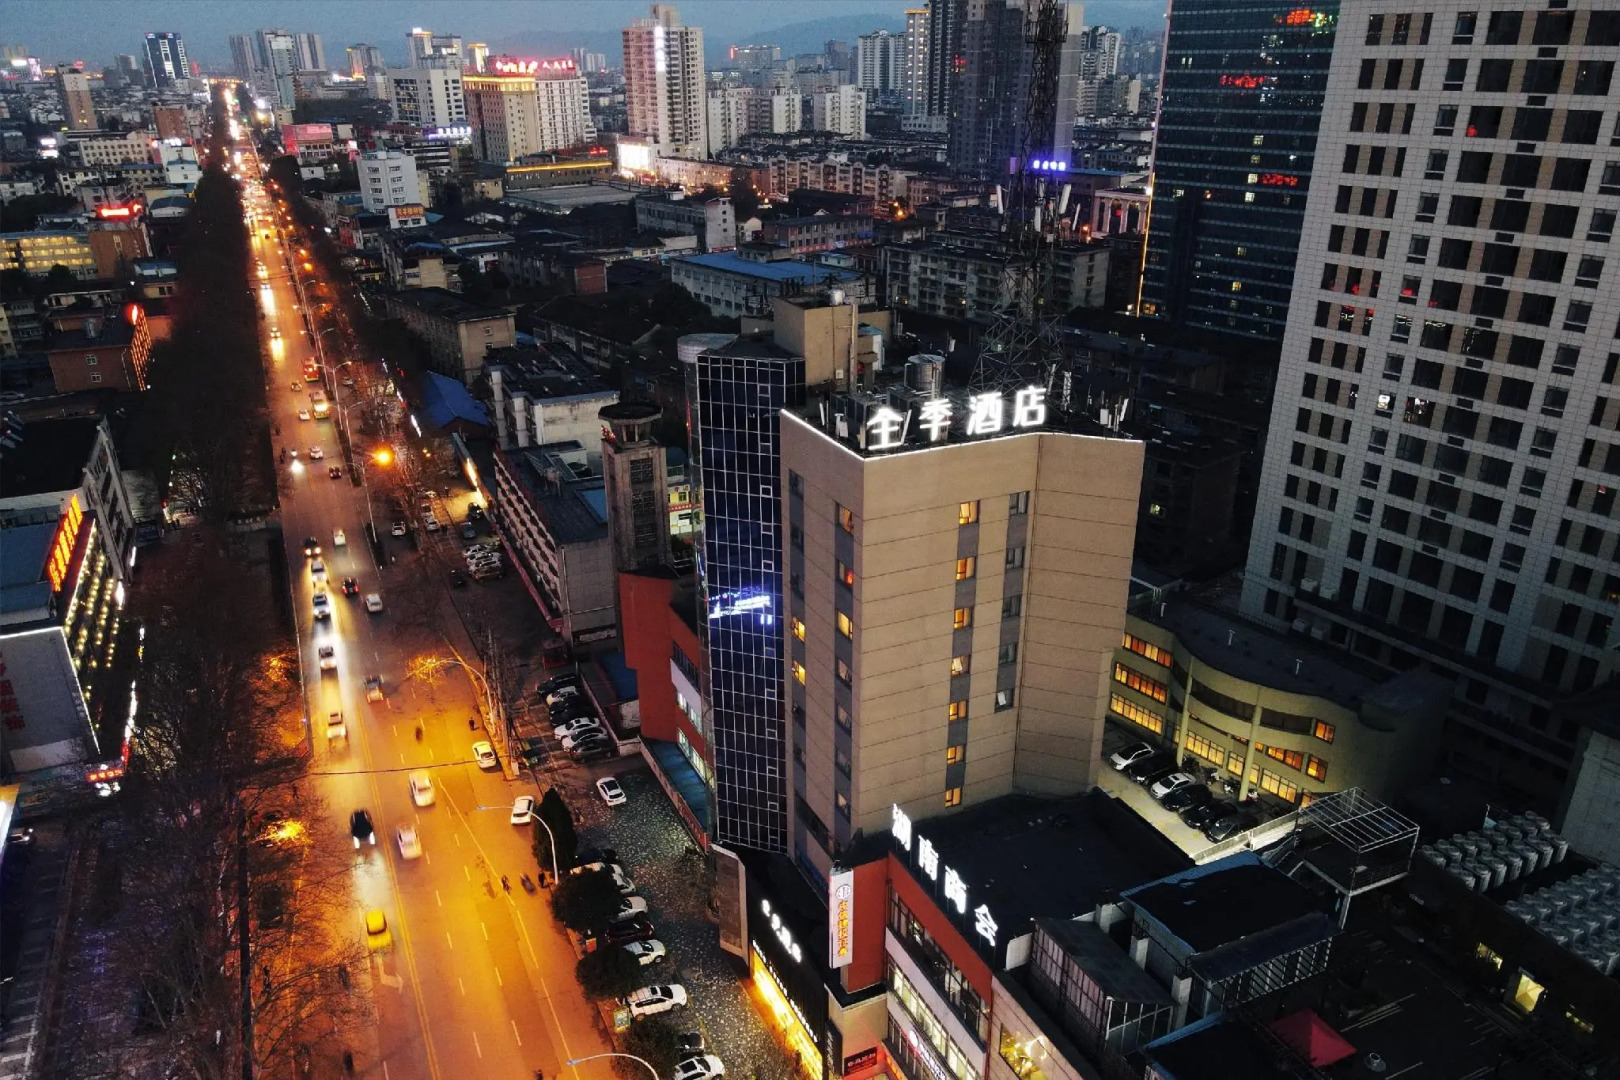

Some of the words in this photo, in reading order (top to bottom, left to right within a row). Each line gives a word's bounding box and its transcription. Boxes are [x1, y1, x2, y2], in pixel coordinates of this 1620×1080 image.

[866, 385, 1048, 451] 全季酒店
[891, 803, 999, 947] 湖南商会
